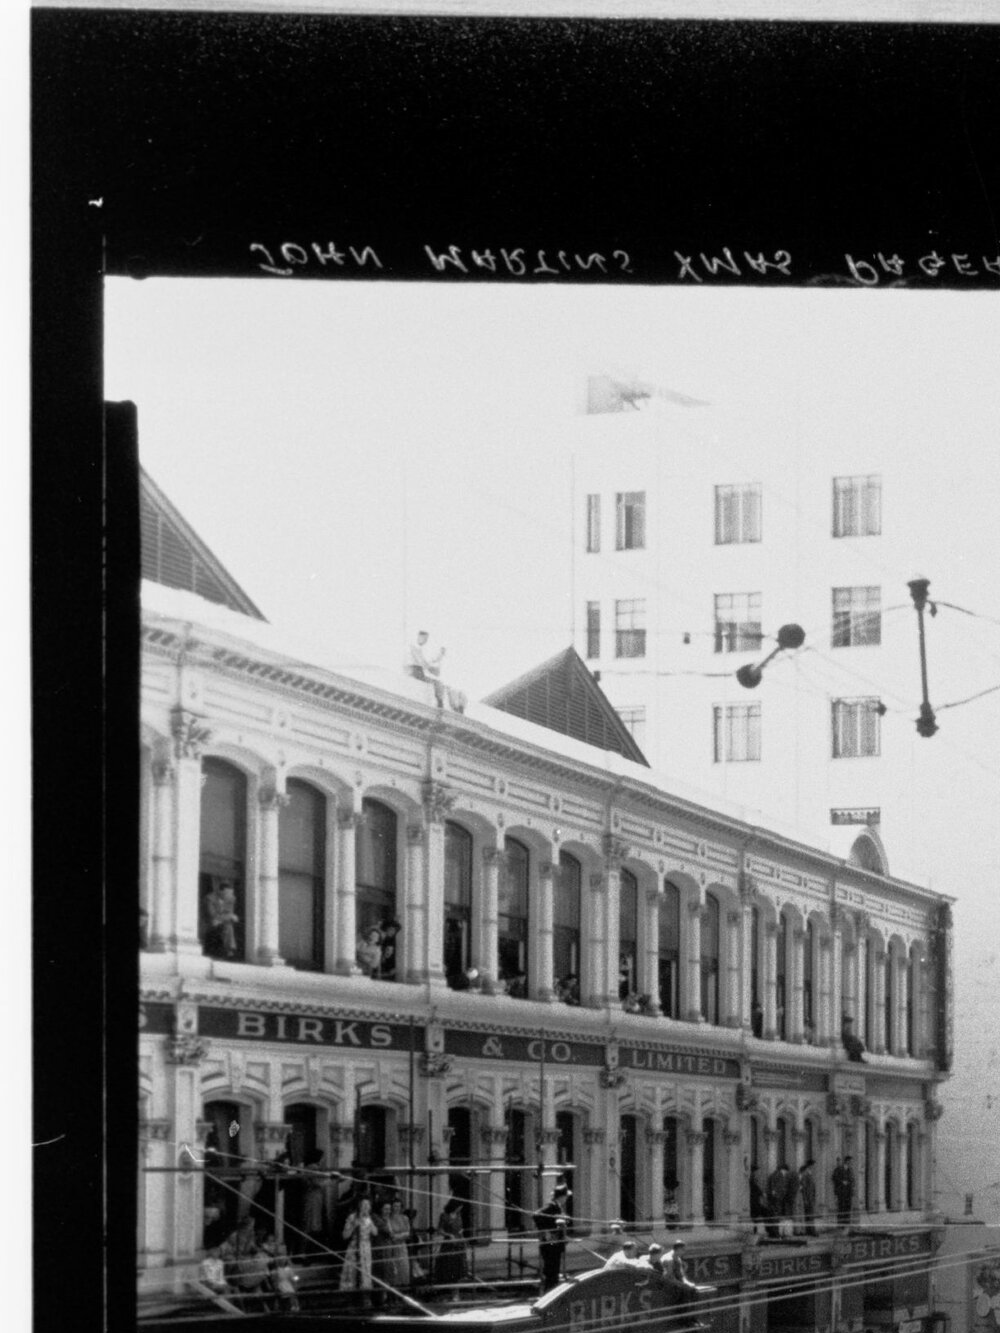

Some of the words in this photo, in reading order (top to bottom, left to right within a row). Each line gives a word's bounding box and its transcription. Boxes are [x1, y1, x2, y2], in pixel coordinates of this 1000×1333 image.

[236, 1012, 393, 1047] BIRKS
[482, 1036, 504, 1058] &
[632, 1050, 727, 1075] LIMITED
[854, 1235, 920, 1259] BIRKS
[759, 1255, 823, 1277] BIRKS
[569, 1288, 655, 1333] BIRKS
